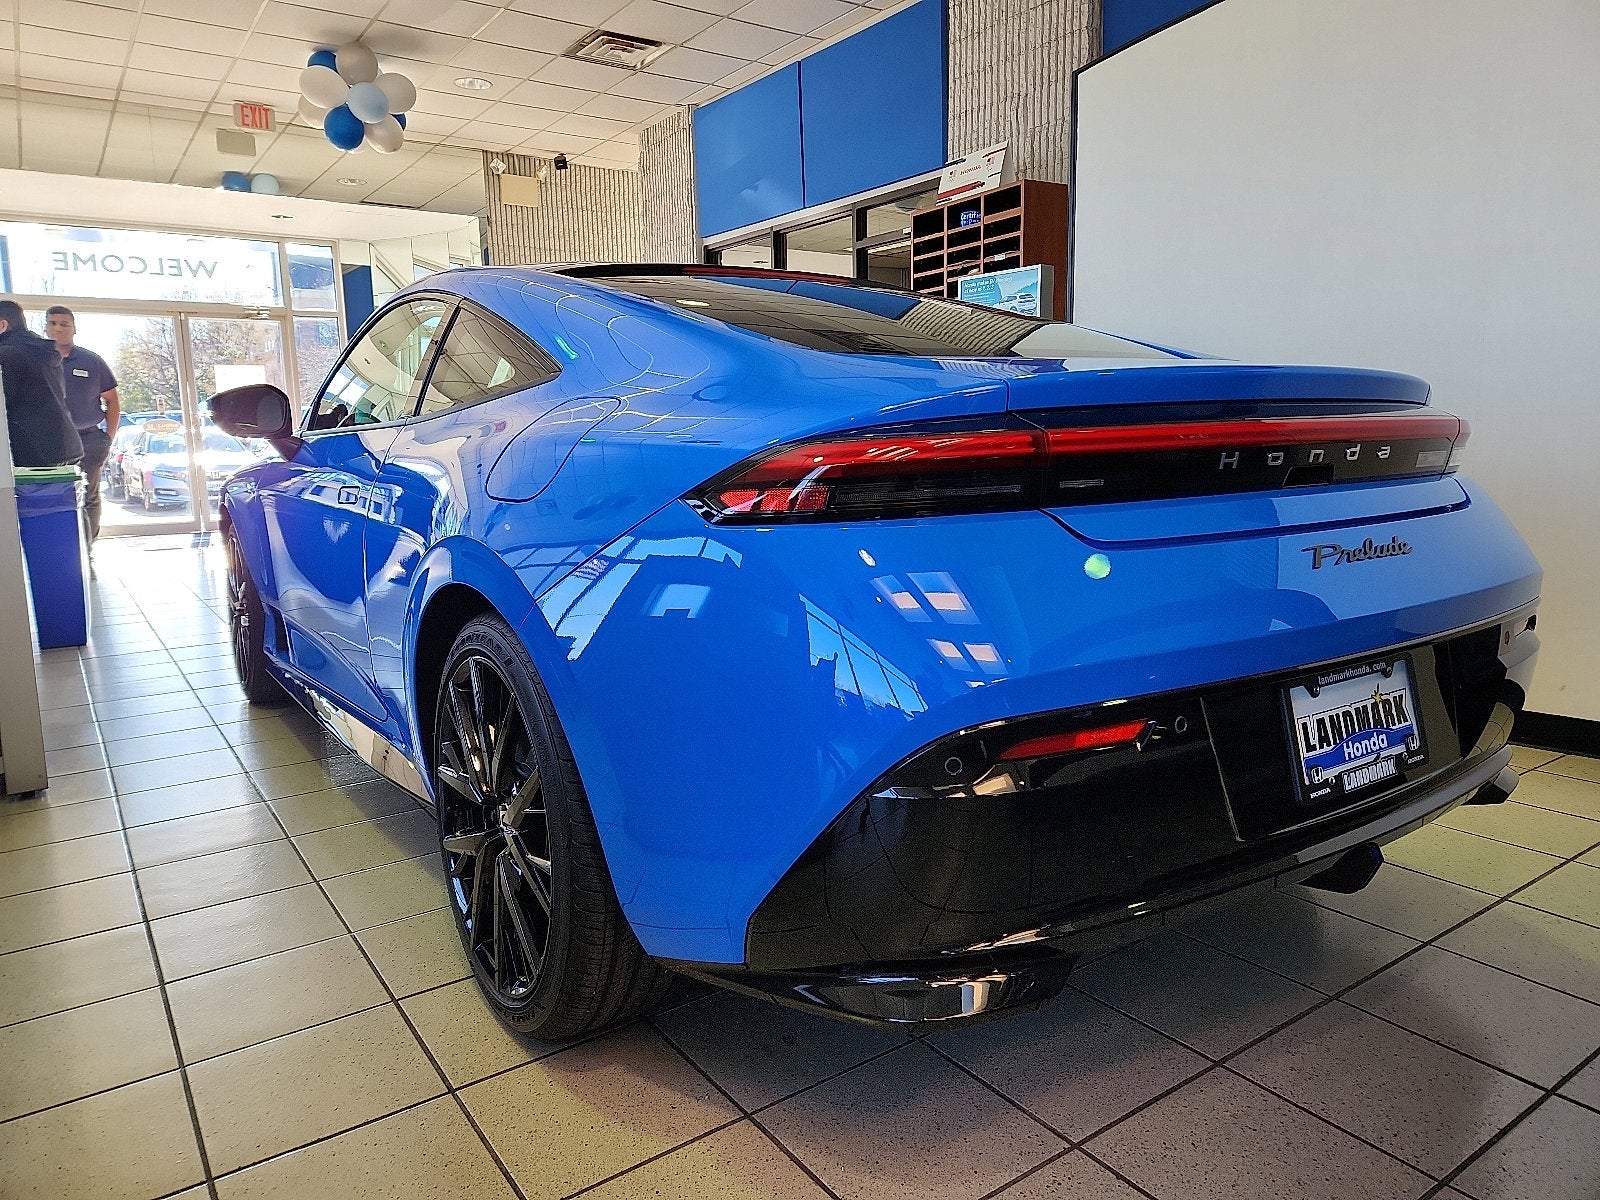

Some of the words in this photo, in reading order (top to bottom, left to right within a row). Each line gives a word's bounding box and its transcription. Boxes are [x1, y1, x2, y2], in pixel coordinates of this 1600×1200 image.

[240, 104, 270, 130] EXIT
[1300, 535, 1413, 571] Prelude
[1297, 692, 1410, 753] LANDMARK
[1343, 730, 1389, 761] Honda
[1343, 758, 1397, 791] LANDMARK
[1309, 787, 1331, 799] HONDA
